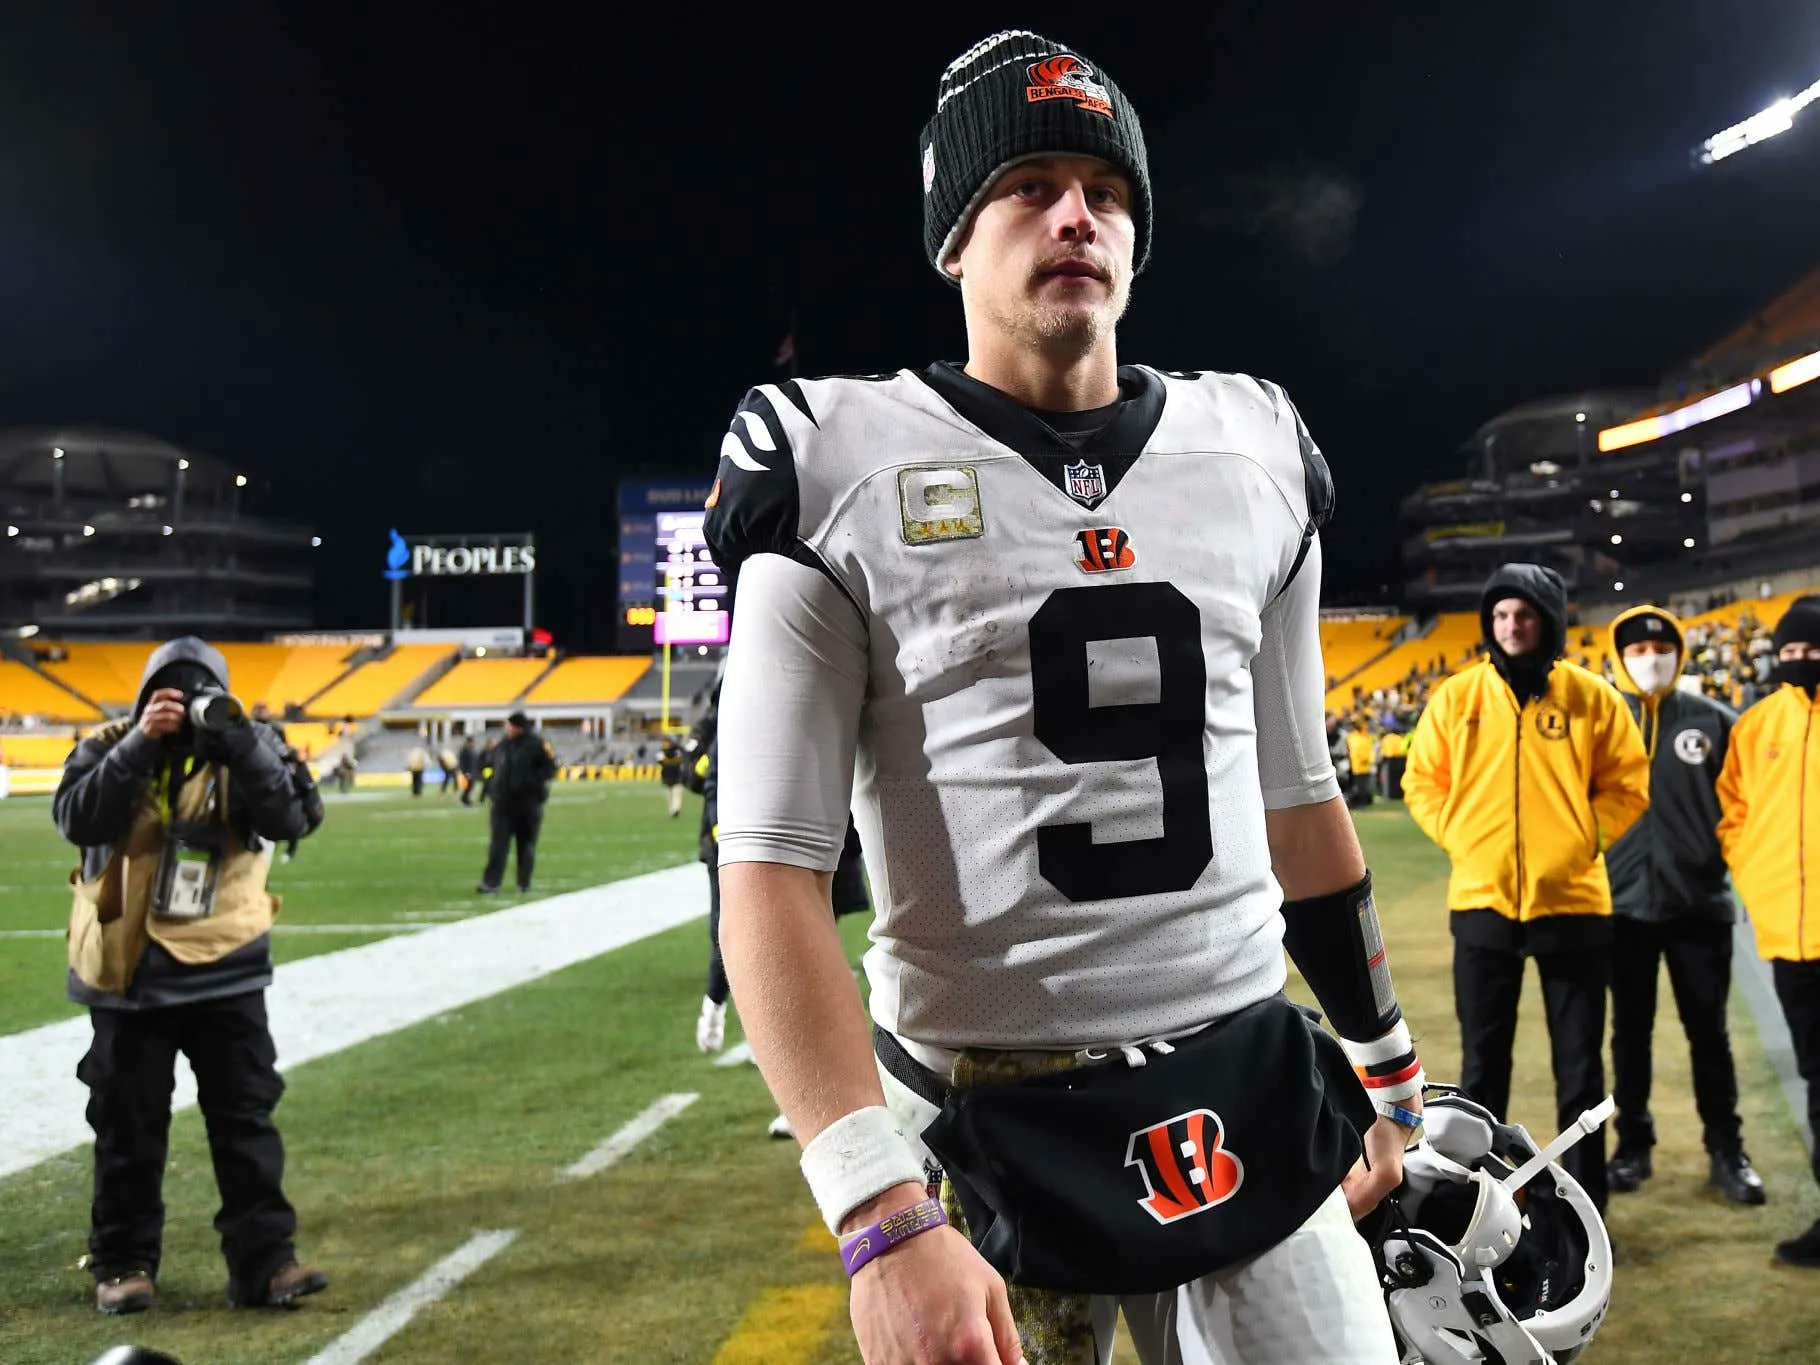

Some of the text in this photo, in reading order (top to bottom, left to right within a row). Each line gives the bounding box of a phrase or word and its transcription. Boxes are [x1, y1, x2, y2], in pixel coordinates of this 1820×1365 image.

[1030, 87, 1083, 99] BENGALS
[1087, 99, 1108, 109] AFC
[1072, 479, 1101, 495] NFL
[413, 545, 536, 575] PEOPLES
[1549, 715, 1562, 731] L
[1028, 581, 1214, 902] 9
